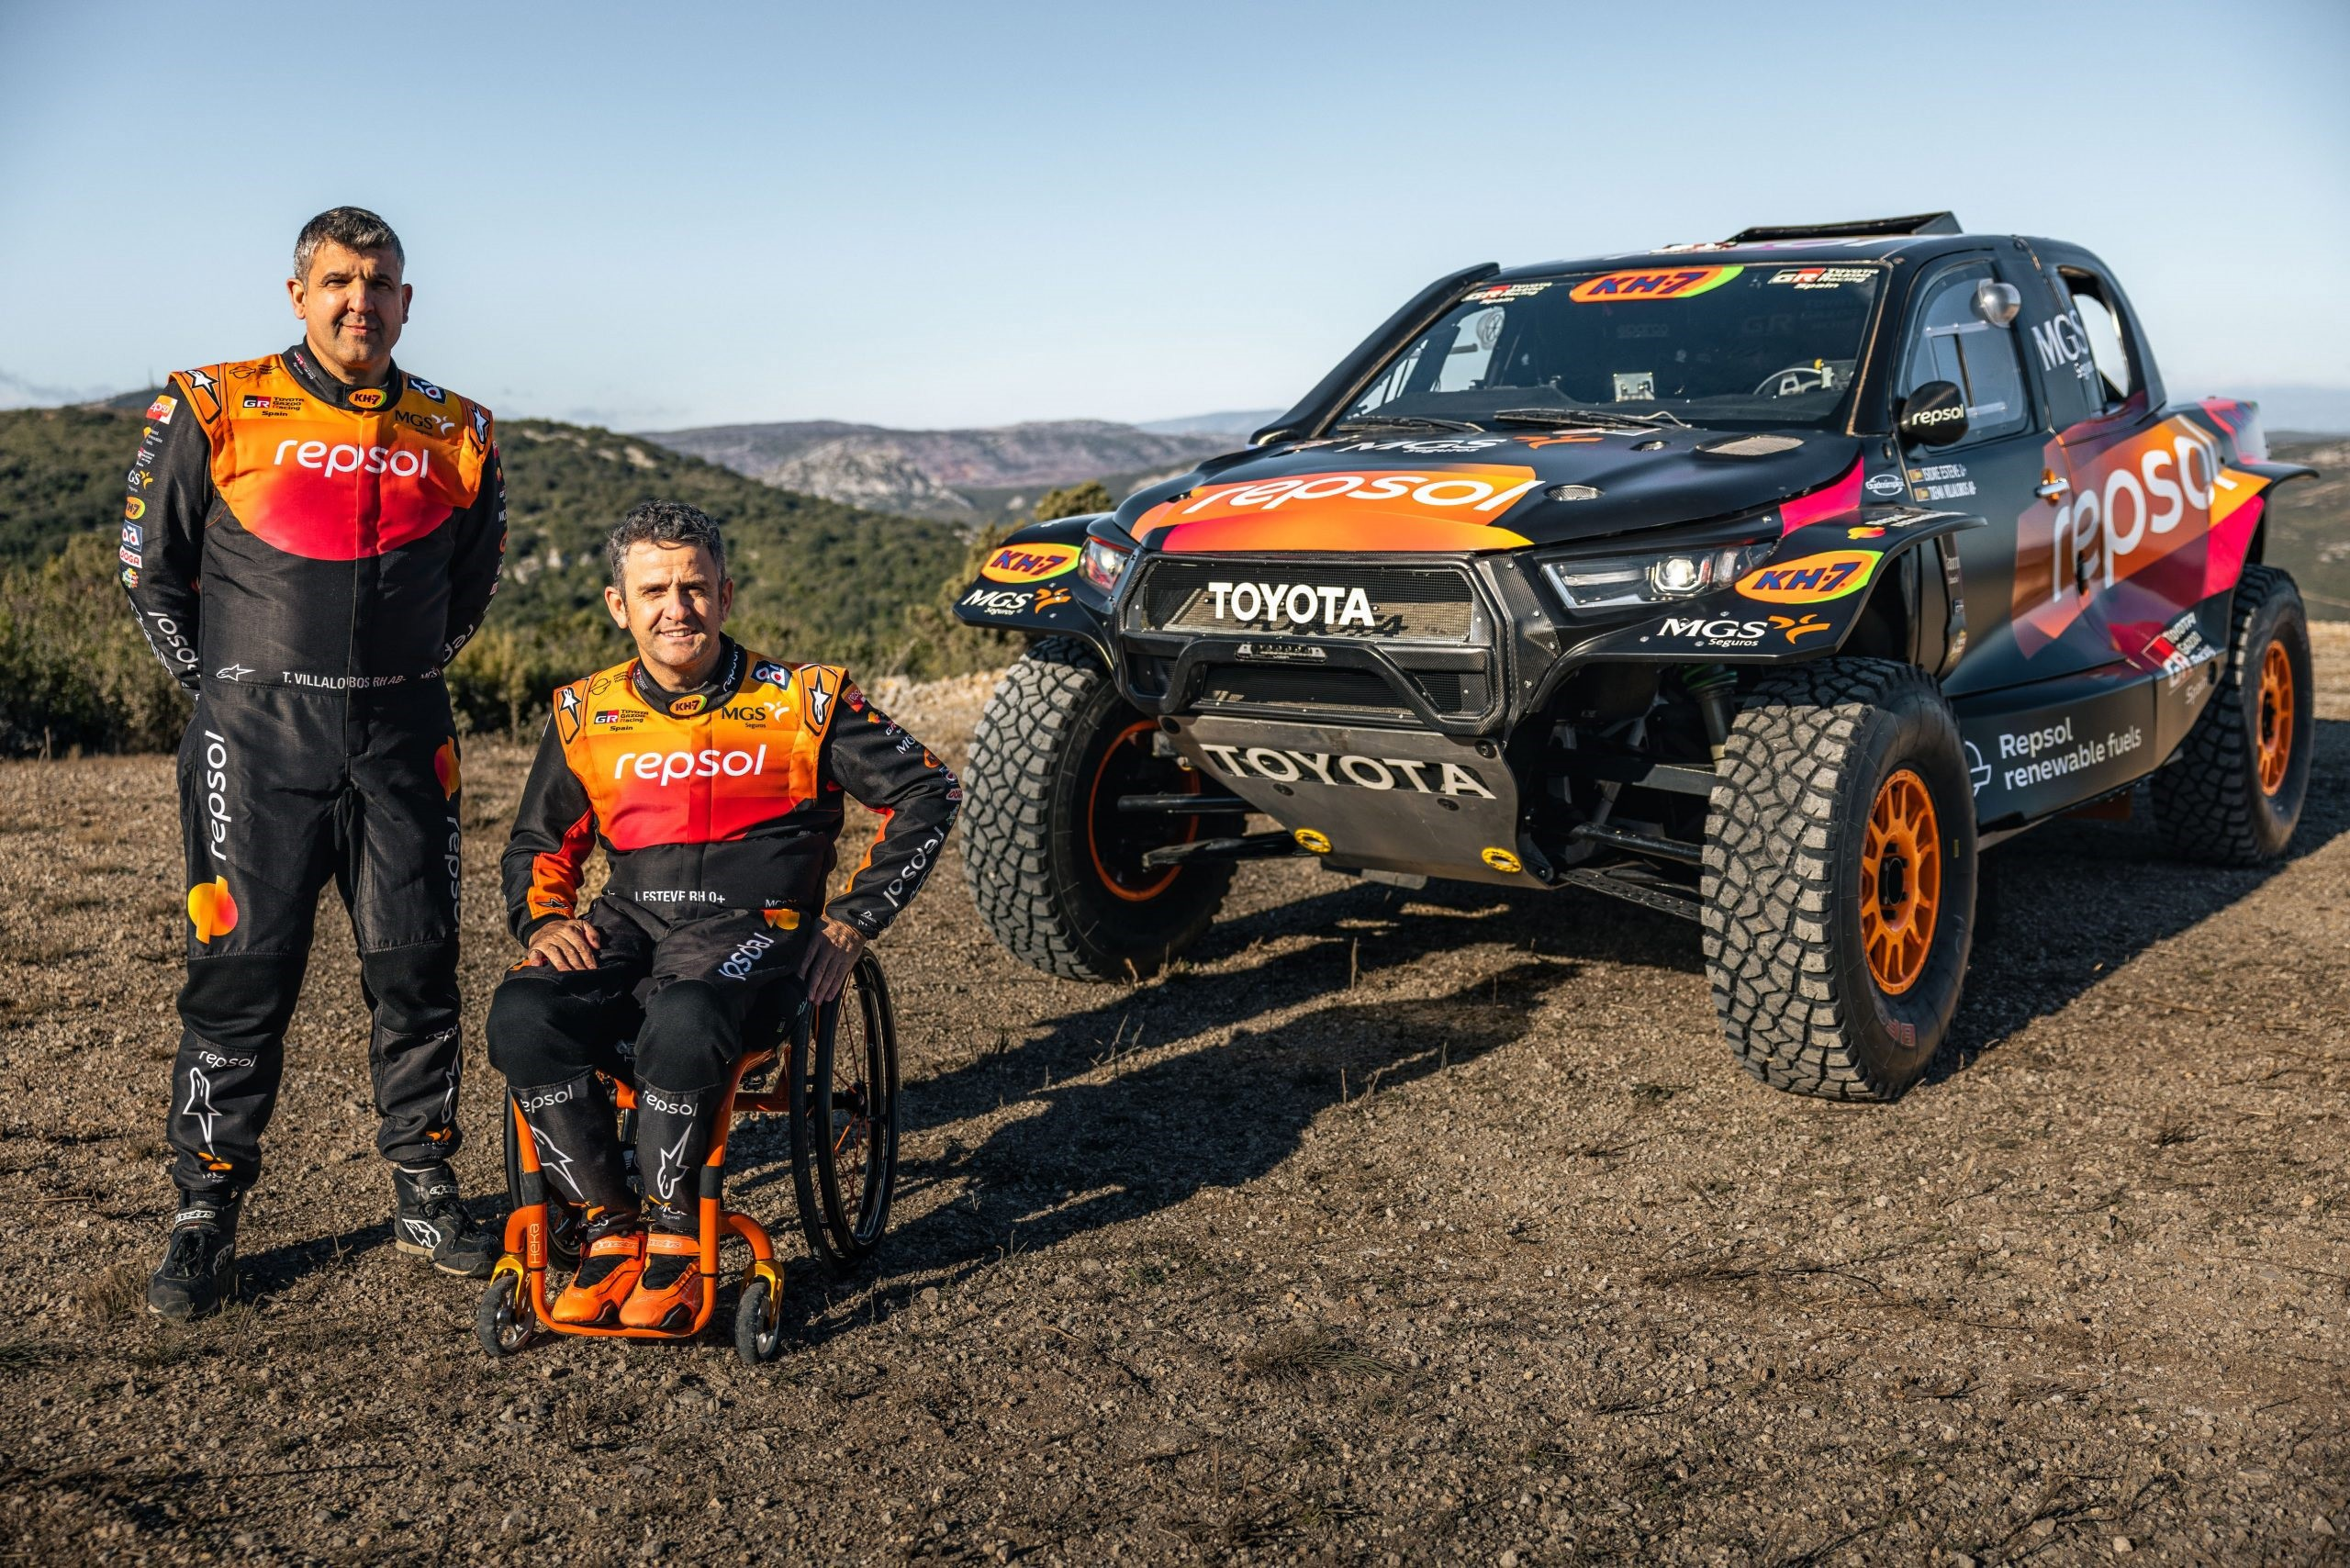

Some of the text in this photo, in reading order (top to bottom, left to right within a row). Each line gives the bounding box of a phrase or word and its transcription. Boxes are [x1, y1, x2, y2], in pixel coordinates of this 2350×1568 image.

[1771, 274, 1819, 283] GR
[2031, 309, 2089, 371] MGS
[243, 399, 270, 409] GR
[395, 410, 433, 430] MGS
[1912, 404, 1964, 426] repsol
[1337, 439, 1507, 453] MGS
[274, 439, 430, 478] repsol
[128, 470, 140, 485] GS
[1183, 476, 1545, 515] repsol
[2053, 414, 2238, 603] repsol
[961, 589, 1034, 609] MGS
[1208, 582, 1375, 626] TOYOTA
[1656, 618, 1769, 639] MGS
[1707, 637, 1759, 647] Seguros
[282, 671, 291, 684] T.
[295, 673, 370, 689] VILLALOBOS
[372, 677, 387, 689] RH
[595, 715, 619, 723] GR
[722, 706, 767, 721] MGS
[1998, 717, 2073, 759] Repsol
[614, 744, 767, 786] repsol
[2005, 724, 2142, 790] renewable fuels
[1200, 744, 1496, 800] TOYOTA
[205, 730, 231, 861] repsol
[883, 826, 945, 907] repsol
[643, 890, 686, 902] ESTEVE
[689, 891, 705, 902] RH
[198, 1049, 258, 1070] repsol
